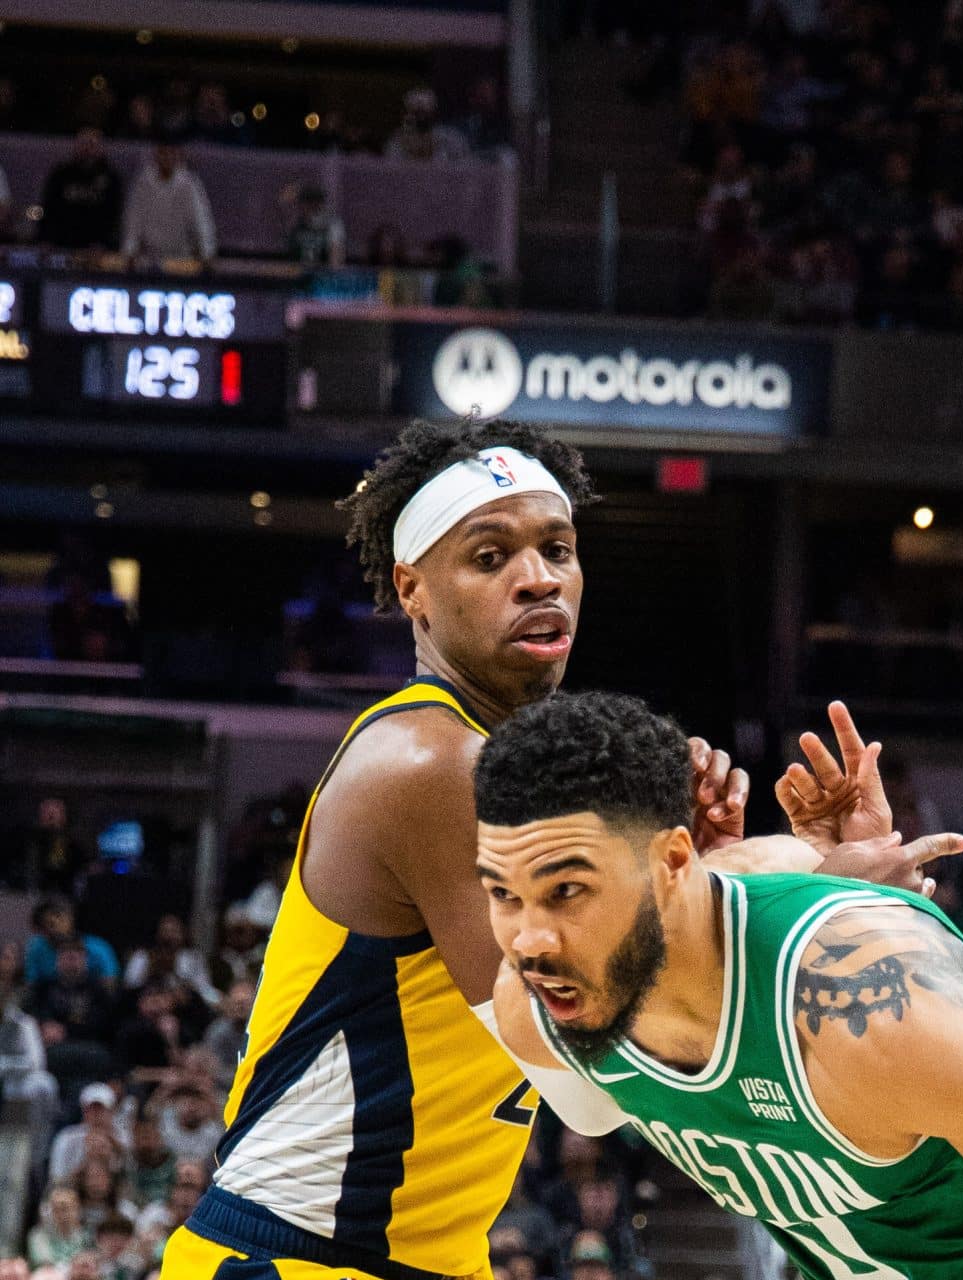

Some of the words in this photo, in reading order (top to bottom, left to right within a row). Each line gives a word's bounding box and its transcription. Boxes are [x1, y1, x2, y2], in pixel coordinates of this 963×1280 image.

[68, 286, 236, 339] CELTICS
[124, 345, 200, 400] 125
[525, 347, 793, 410] motorola
[738, 1077, 792, 1106] VISTA
[747, 1102, 798, 1122] PRINT
